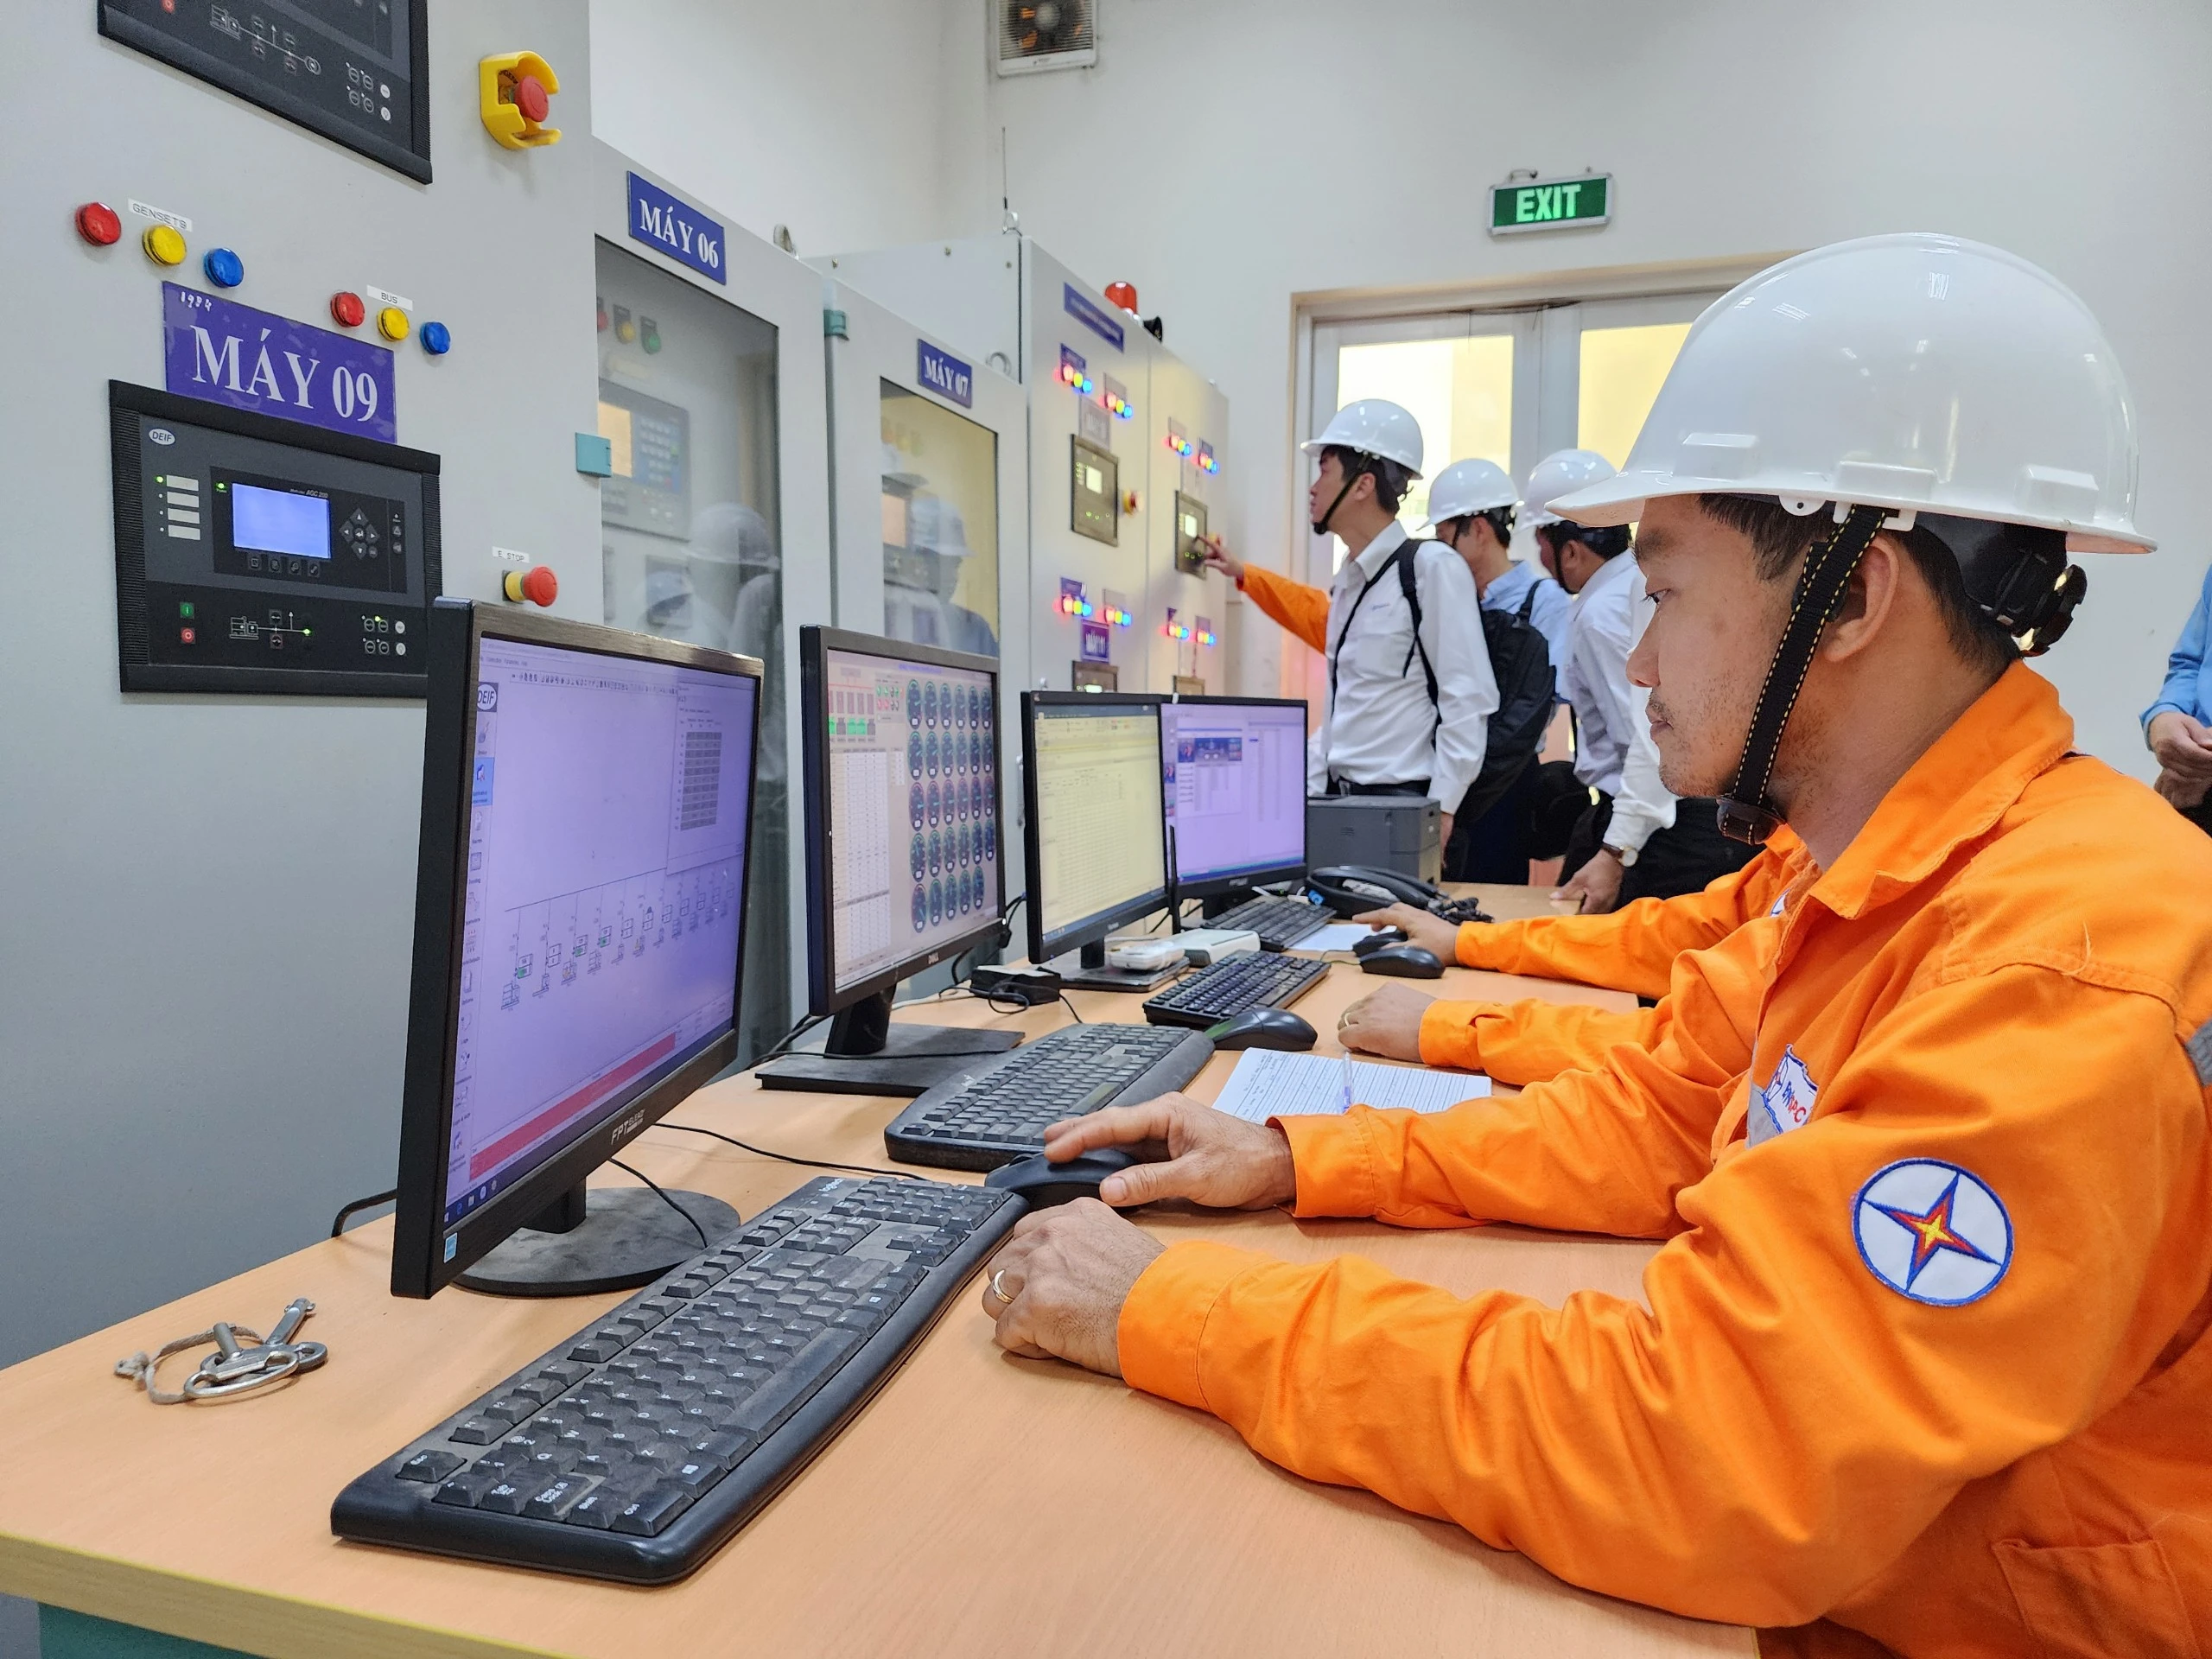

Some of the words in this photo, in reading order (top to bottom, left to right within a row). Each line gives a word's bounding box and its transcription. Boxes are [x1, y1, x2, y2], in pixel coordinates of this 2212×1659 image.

[133, 203, 187, 229] GENSETS
[1516, 183, 1581, 222] EXIT
[639, 198, 694, 254] MÁY
[698, 232, 719, 269] 06
[381, 292, 398, 304] BUS
[190, 324, 320, 409] MÁY
[332, 365, 378, 423] 09
[924, 354, 955, 391] MÁY
[955, 372, 969, 397] 07
[152, 431, 172, 442] DEIF
[611, 1120, 629, 1146] FPT
